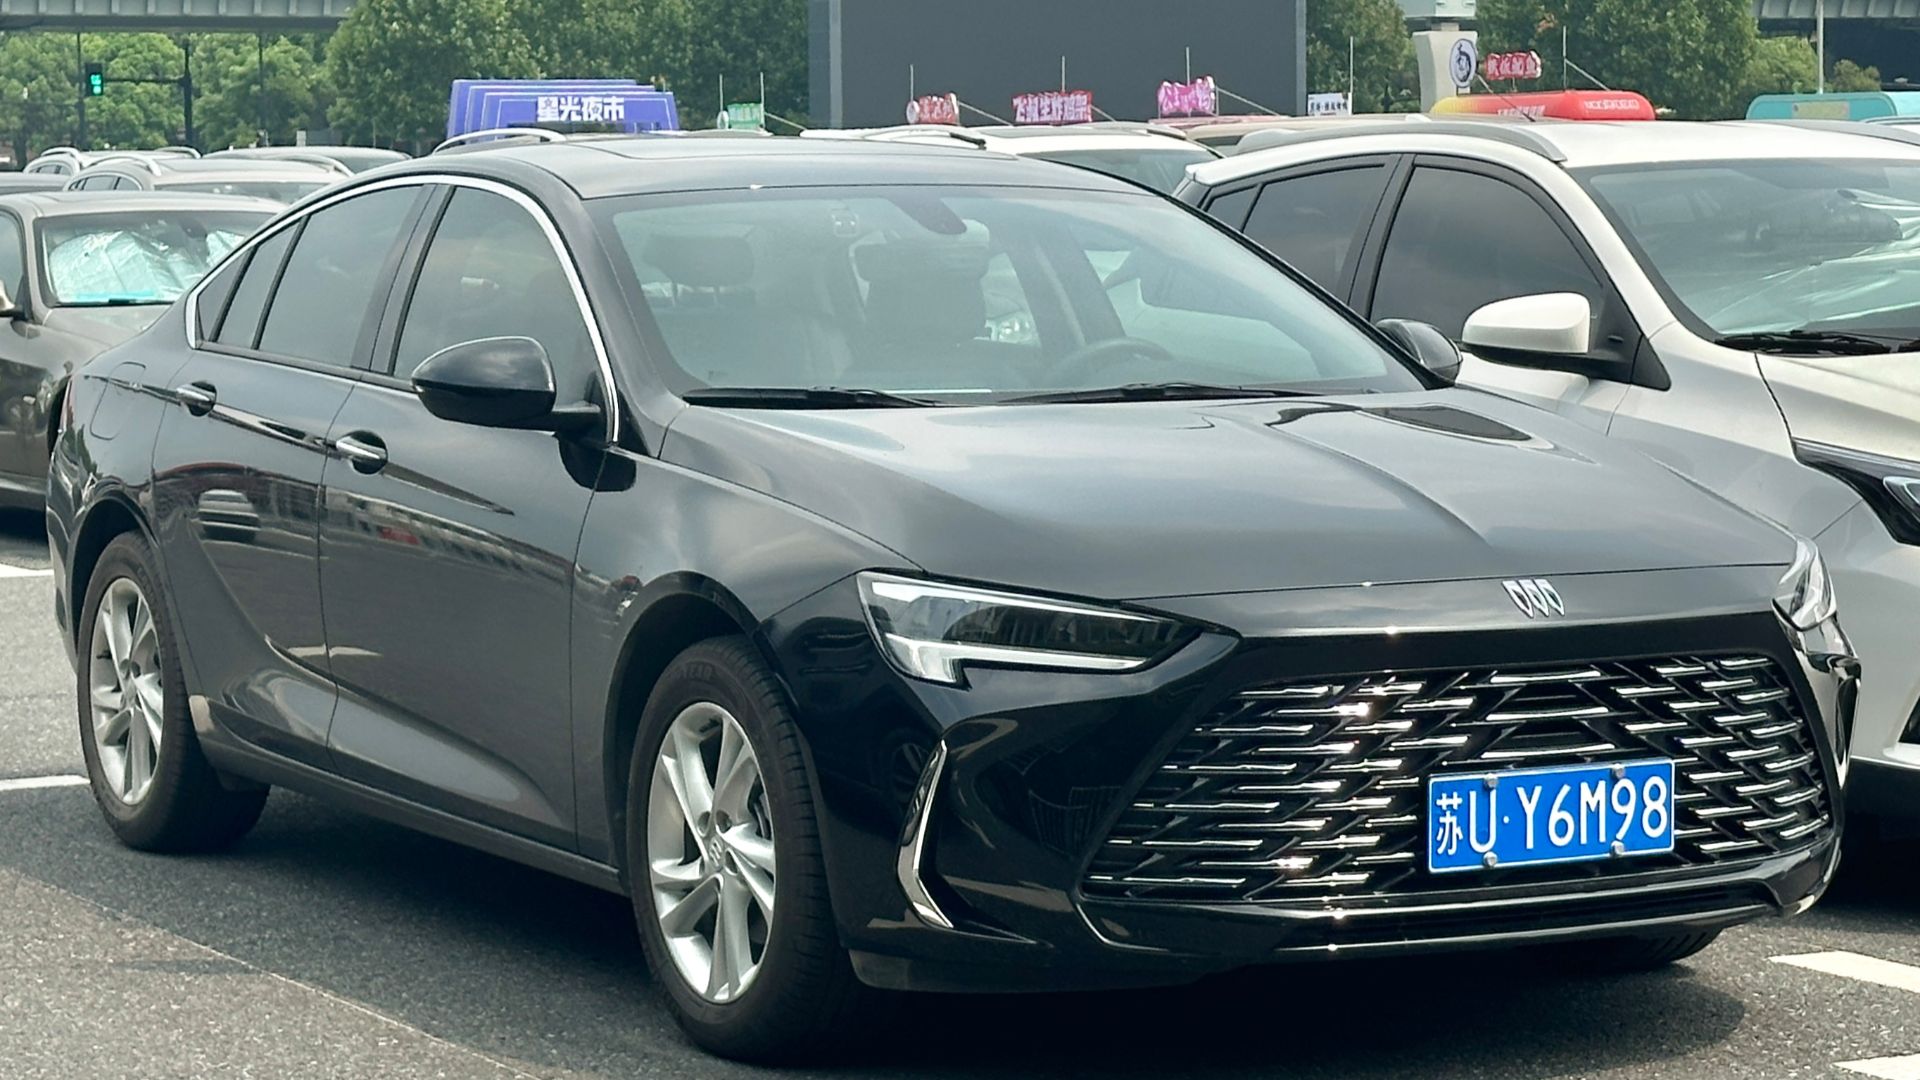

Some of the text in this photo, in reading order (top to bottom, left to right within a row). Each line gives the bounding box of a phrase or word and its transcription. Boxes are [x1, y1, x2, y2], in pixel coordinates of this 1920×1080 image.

[537, 95, 625, 122] 星光夜市
[1435, 774, 1669, 856] 苏U·Y6M98
